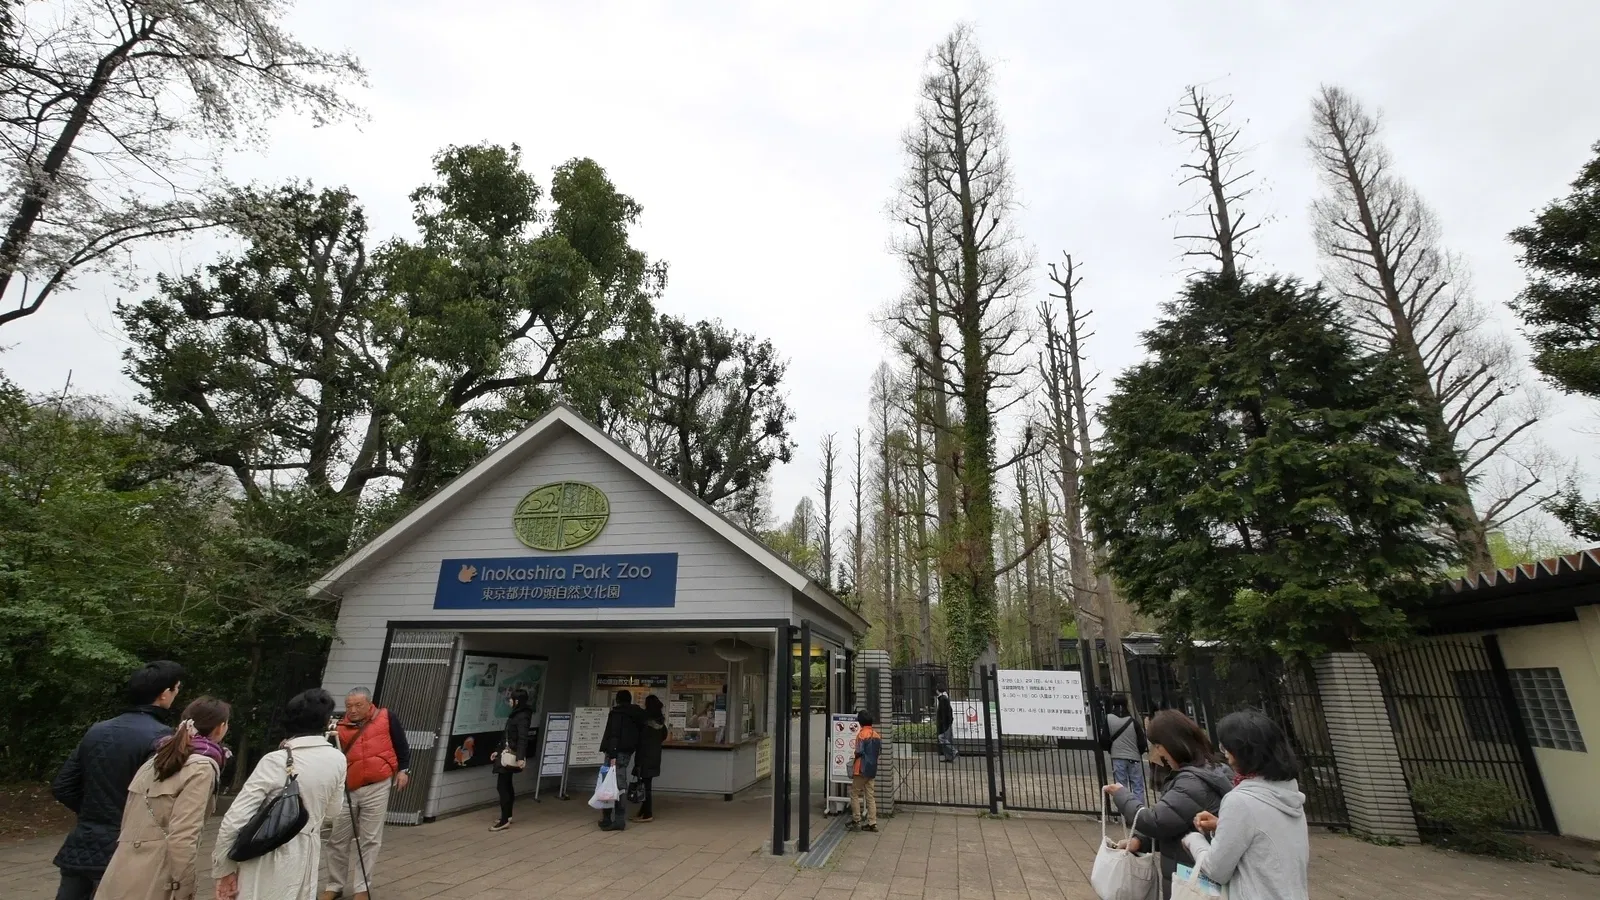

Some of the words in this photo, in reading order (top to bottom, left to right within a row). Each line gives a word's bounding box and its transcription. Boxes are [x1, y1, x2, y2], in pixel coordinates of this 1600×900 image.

[481, 564, 566, 581] Inokashira
[572, 563, 611, 579] Park
[617, 562, 652, 578] Zoo
[482, 584, 620, 600] 東京都井の頭自然文化園
